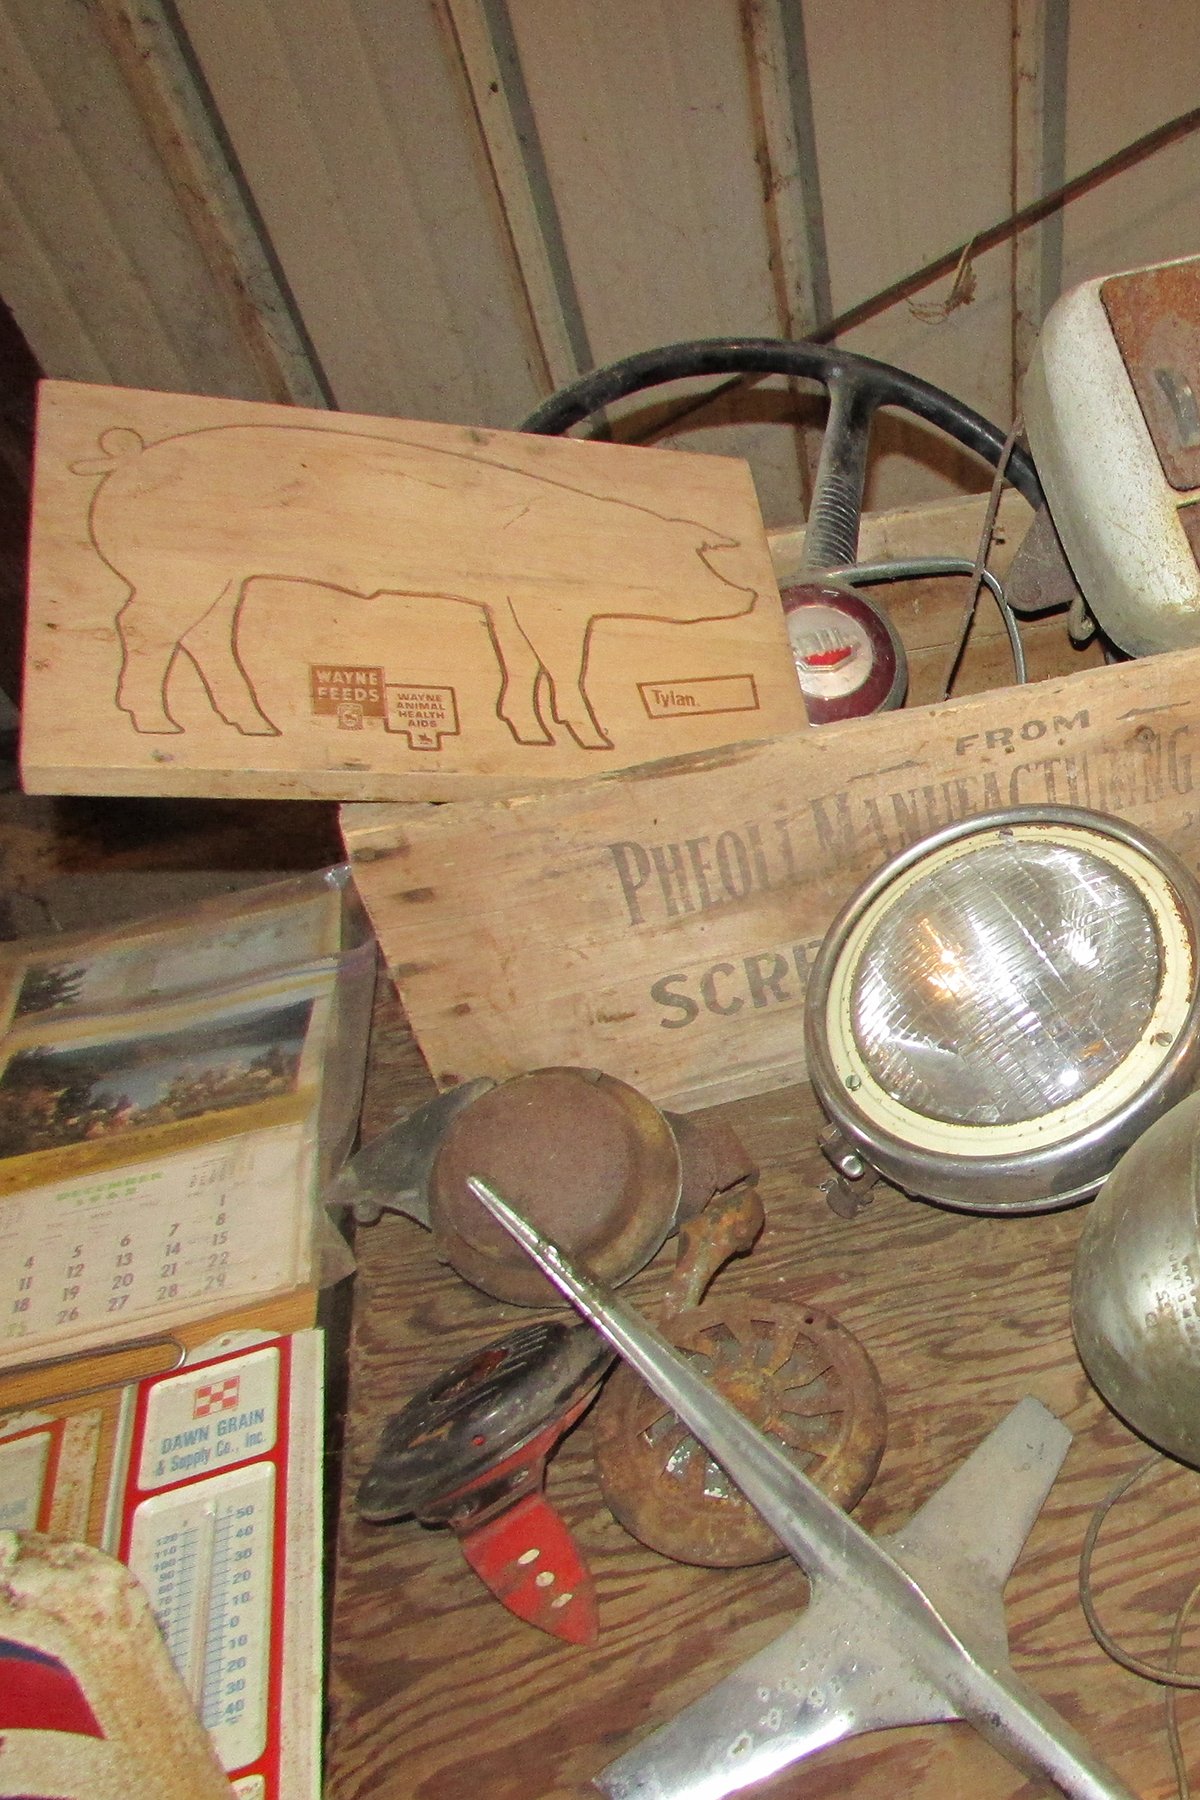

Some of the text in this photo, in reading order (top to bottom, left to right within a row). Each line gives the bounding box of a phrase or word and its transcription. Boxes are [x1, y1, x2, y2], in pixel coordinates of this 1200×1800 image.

[316, 670, 378, 686] WAYNE
[317, 687, 380, 703] FEEDS
[397, 692, 443, 702] WAYNE
[396, 701, 446, 711] ANIMAL
[397, 710, 446, 719] HEALTH
[407, 719, 438, 728] AIDS
[955, 708, 1091, 757] FROM
[24, 1212, 227, 1270] 4 5 6 7 8
[17, 1230, 230, 1292] 11 12 13 14 15
[62, 1284, 81, 1302] 19
[111, 1272, 135, 1291] 20
[160, 1262, 179, 1279] 21
[207, 1251, 230, 1268] 22
[55, 1306, 80, 1325] 26
[106, 1294, 131, 1313] 27
[157, 1283, 179, 1301] 28
[204, 1272, 227, 1291] 29
[161, 1407, 266, 1456] DAWN GRAIN
[170, 1447, 212, 1472] Supply
[236, 1504, 255, 1519] 50
[235, 1524, 254, 1539] 40
[234, 1547, 252, 1562] 30
[232, 1569, 252, 1585] 20
[232, 1590, 251, 1605] 10
[228, 1634, 248, 1649] 10
[226, 1656, 246, 1673] 20
[225, 1678, 246, 1695] 30
[224, 1699, 245, 1715] 40
